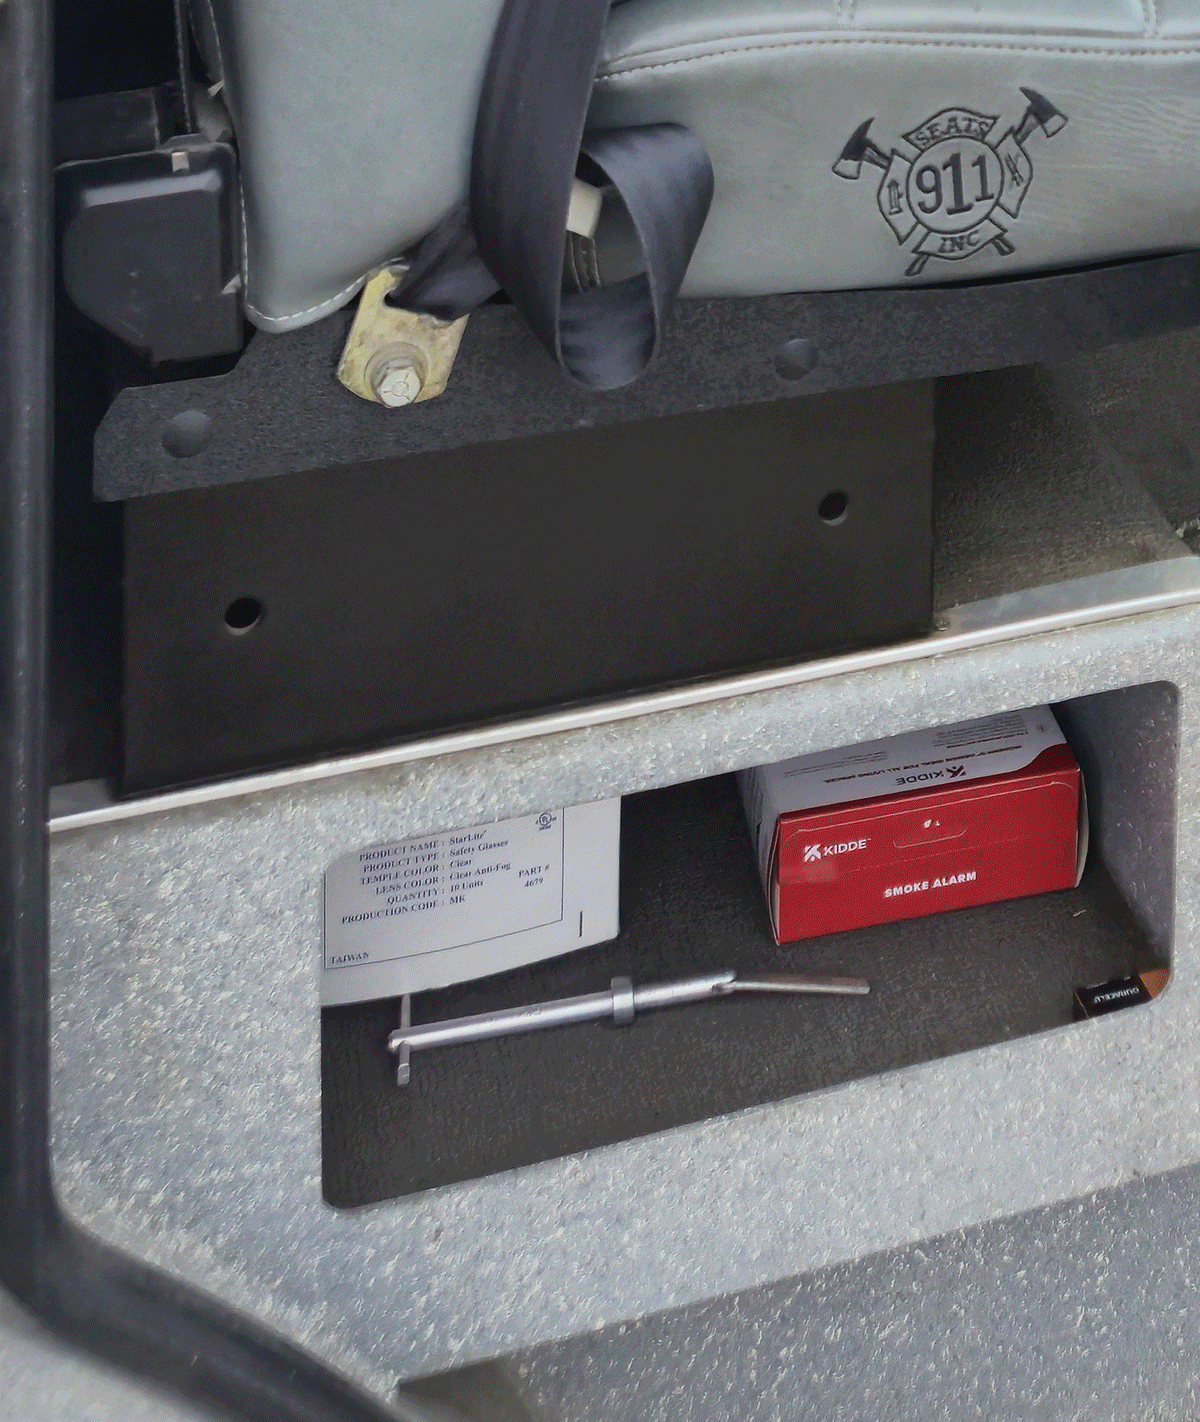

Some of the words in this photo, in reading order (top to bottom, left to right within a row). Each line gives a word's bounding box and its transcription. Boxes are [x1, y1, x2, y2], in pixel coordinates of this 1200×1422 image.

[914, 117, 990, 147] SEATS
[915, 151, 995, 215] 911
[938, 229, 981, 253] INC
[895, 769, 945, 786] KIDDE
[360, 846, 406, 862] PRODUCT
[363, 857, 410, 873] PRODUCT
[450, 846, 475, 857] Safety
[478, 840, 509, 852] Glasses
[824, 839, 867, 857] KIDDE
[361, 870, 401, 885] TEMPLE
[450, 859, 473, 869] Clear
[375, 883, 401, 895] LENS
[450, 871, 473, 881] Clear
[475, 862, 511, 876] Anti-Fog
[518, 866, 542, 878] PART
[524, 877, 544, 888] 4679
[462, 880, 483, 890] Units
[884, 880, 929, 898] SMOKE
[932, 871, 977, 889] ALARM
[342, 906, 409, 925] PRODUCTION
[450, 895, 466, 905] MK
[331, 951, 370, 964] TAIWAN
